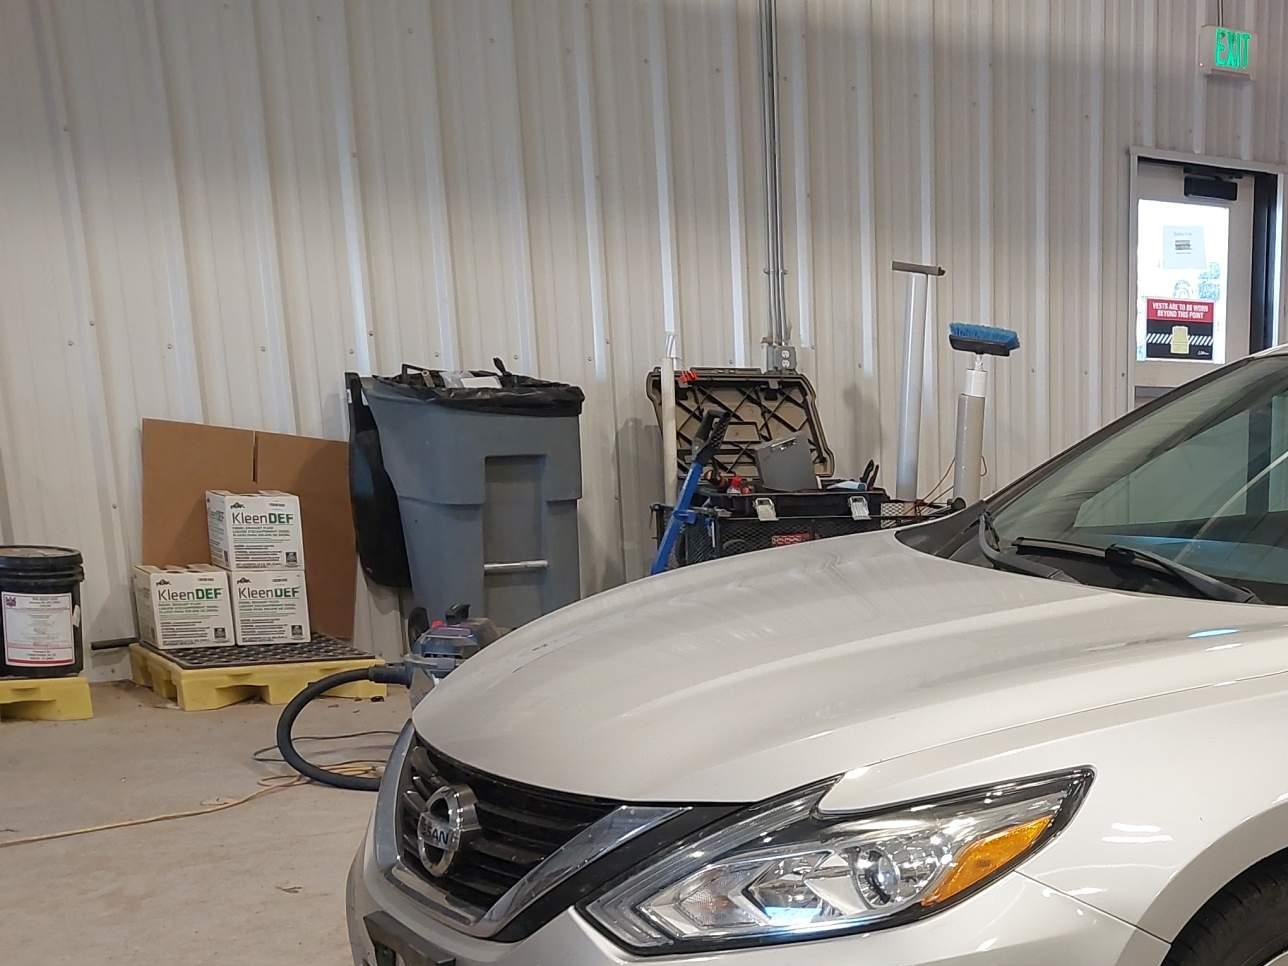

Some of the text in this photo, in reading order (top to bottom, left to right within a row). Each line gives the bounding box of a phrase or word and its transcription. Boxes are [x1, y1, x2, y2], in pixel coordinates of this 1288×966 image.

[1216, 29, 1251, 69] EXIT
[231, 512, 294, 524] KleenDEF
[158, 588, 224, 601] KleenDEF
[238, 586, 300, 599] KleenDEF
